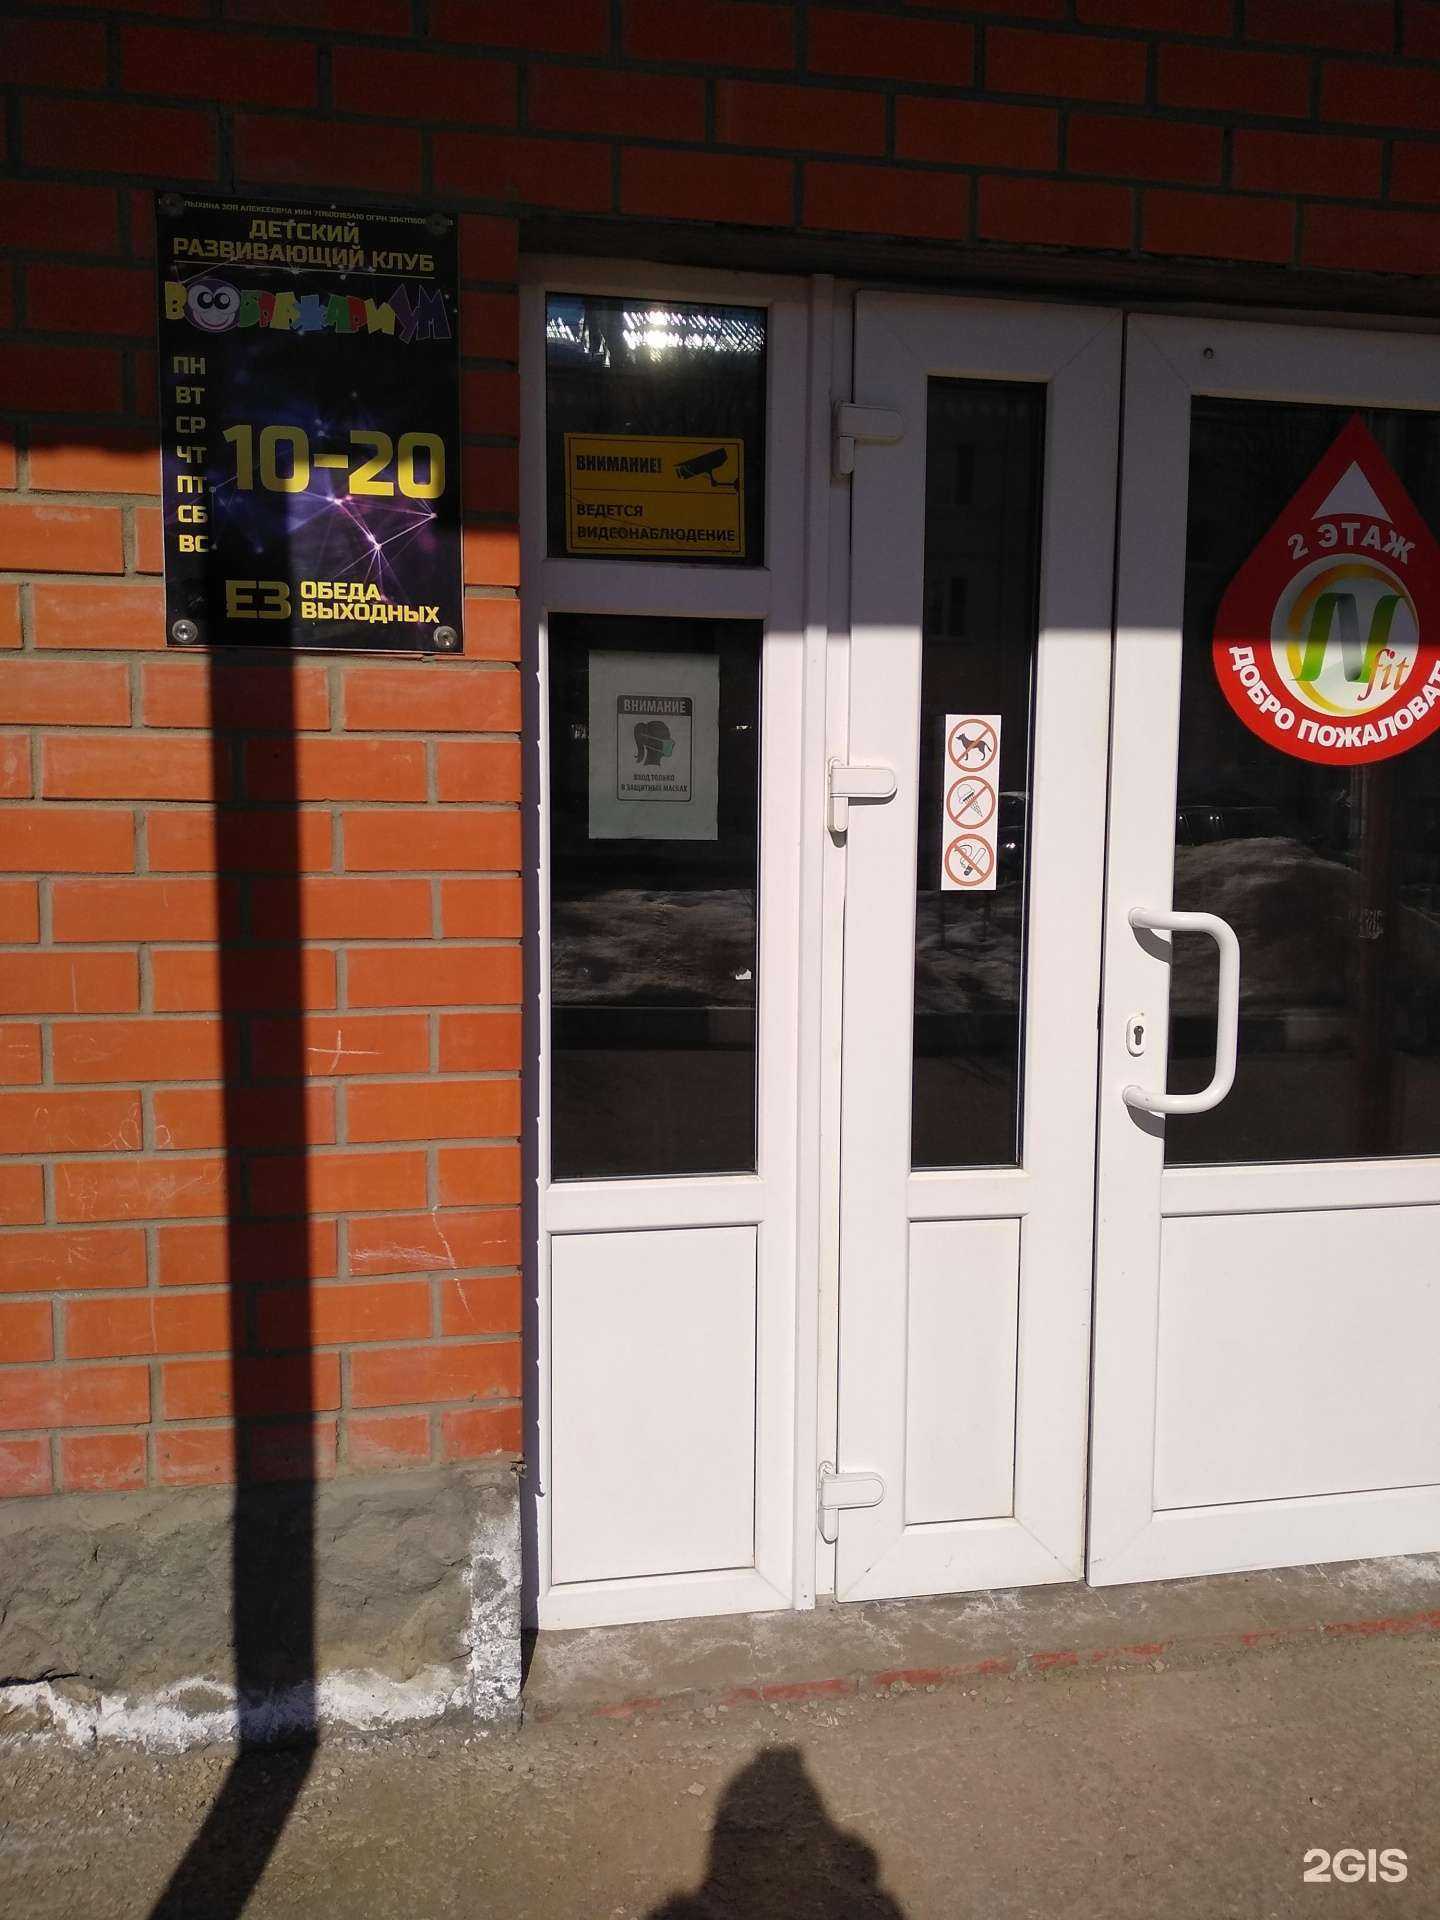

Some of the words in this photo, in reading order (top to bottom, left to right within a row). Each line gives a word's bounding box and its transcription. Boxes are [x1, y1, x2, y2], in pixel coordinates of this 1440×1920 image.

[249, 218, 361, 245] ДЕТСКИЙ
[173, 237, 366, 268] РАЗВИВАЮЩИЙ
[372, 251, 435, 273] КЛУБ
[173, 356, 206, 376] ПН
[175, 386, 206, 405] ВТ
[175, 416, 206, 434] СР
[176, 446, 206, 464] ЧТ
[222, 424, 446, 499] 10-20
[576, 455, 662, 474] ВНИМАНИЕ!
[177, 475, 207, 493] ПТ
[177, 505, 208, 523] СБ
[576, 503, 643, 517] ВЕДЕТСЯ
[178, 534, 210, 552] ВС
[577, 526, 736, 542] ВИДЕОНАБЛЮДЕНИЕ
[1288, 533, 1310, 560] 2
[1317, 522, 1416, 565] ЭТАЖ
[300, 581, 382, 602] ОБЕДА
[301, 602, 440, 624] ВЫХОДНЫХ
[1229, 646, 1296, 730] ДОБРО
[624, 700, 686, 714] ВНИМАНИЕ
[664, 785, 688, 793] МАСКАХ
